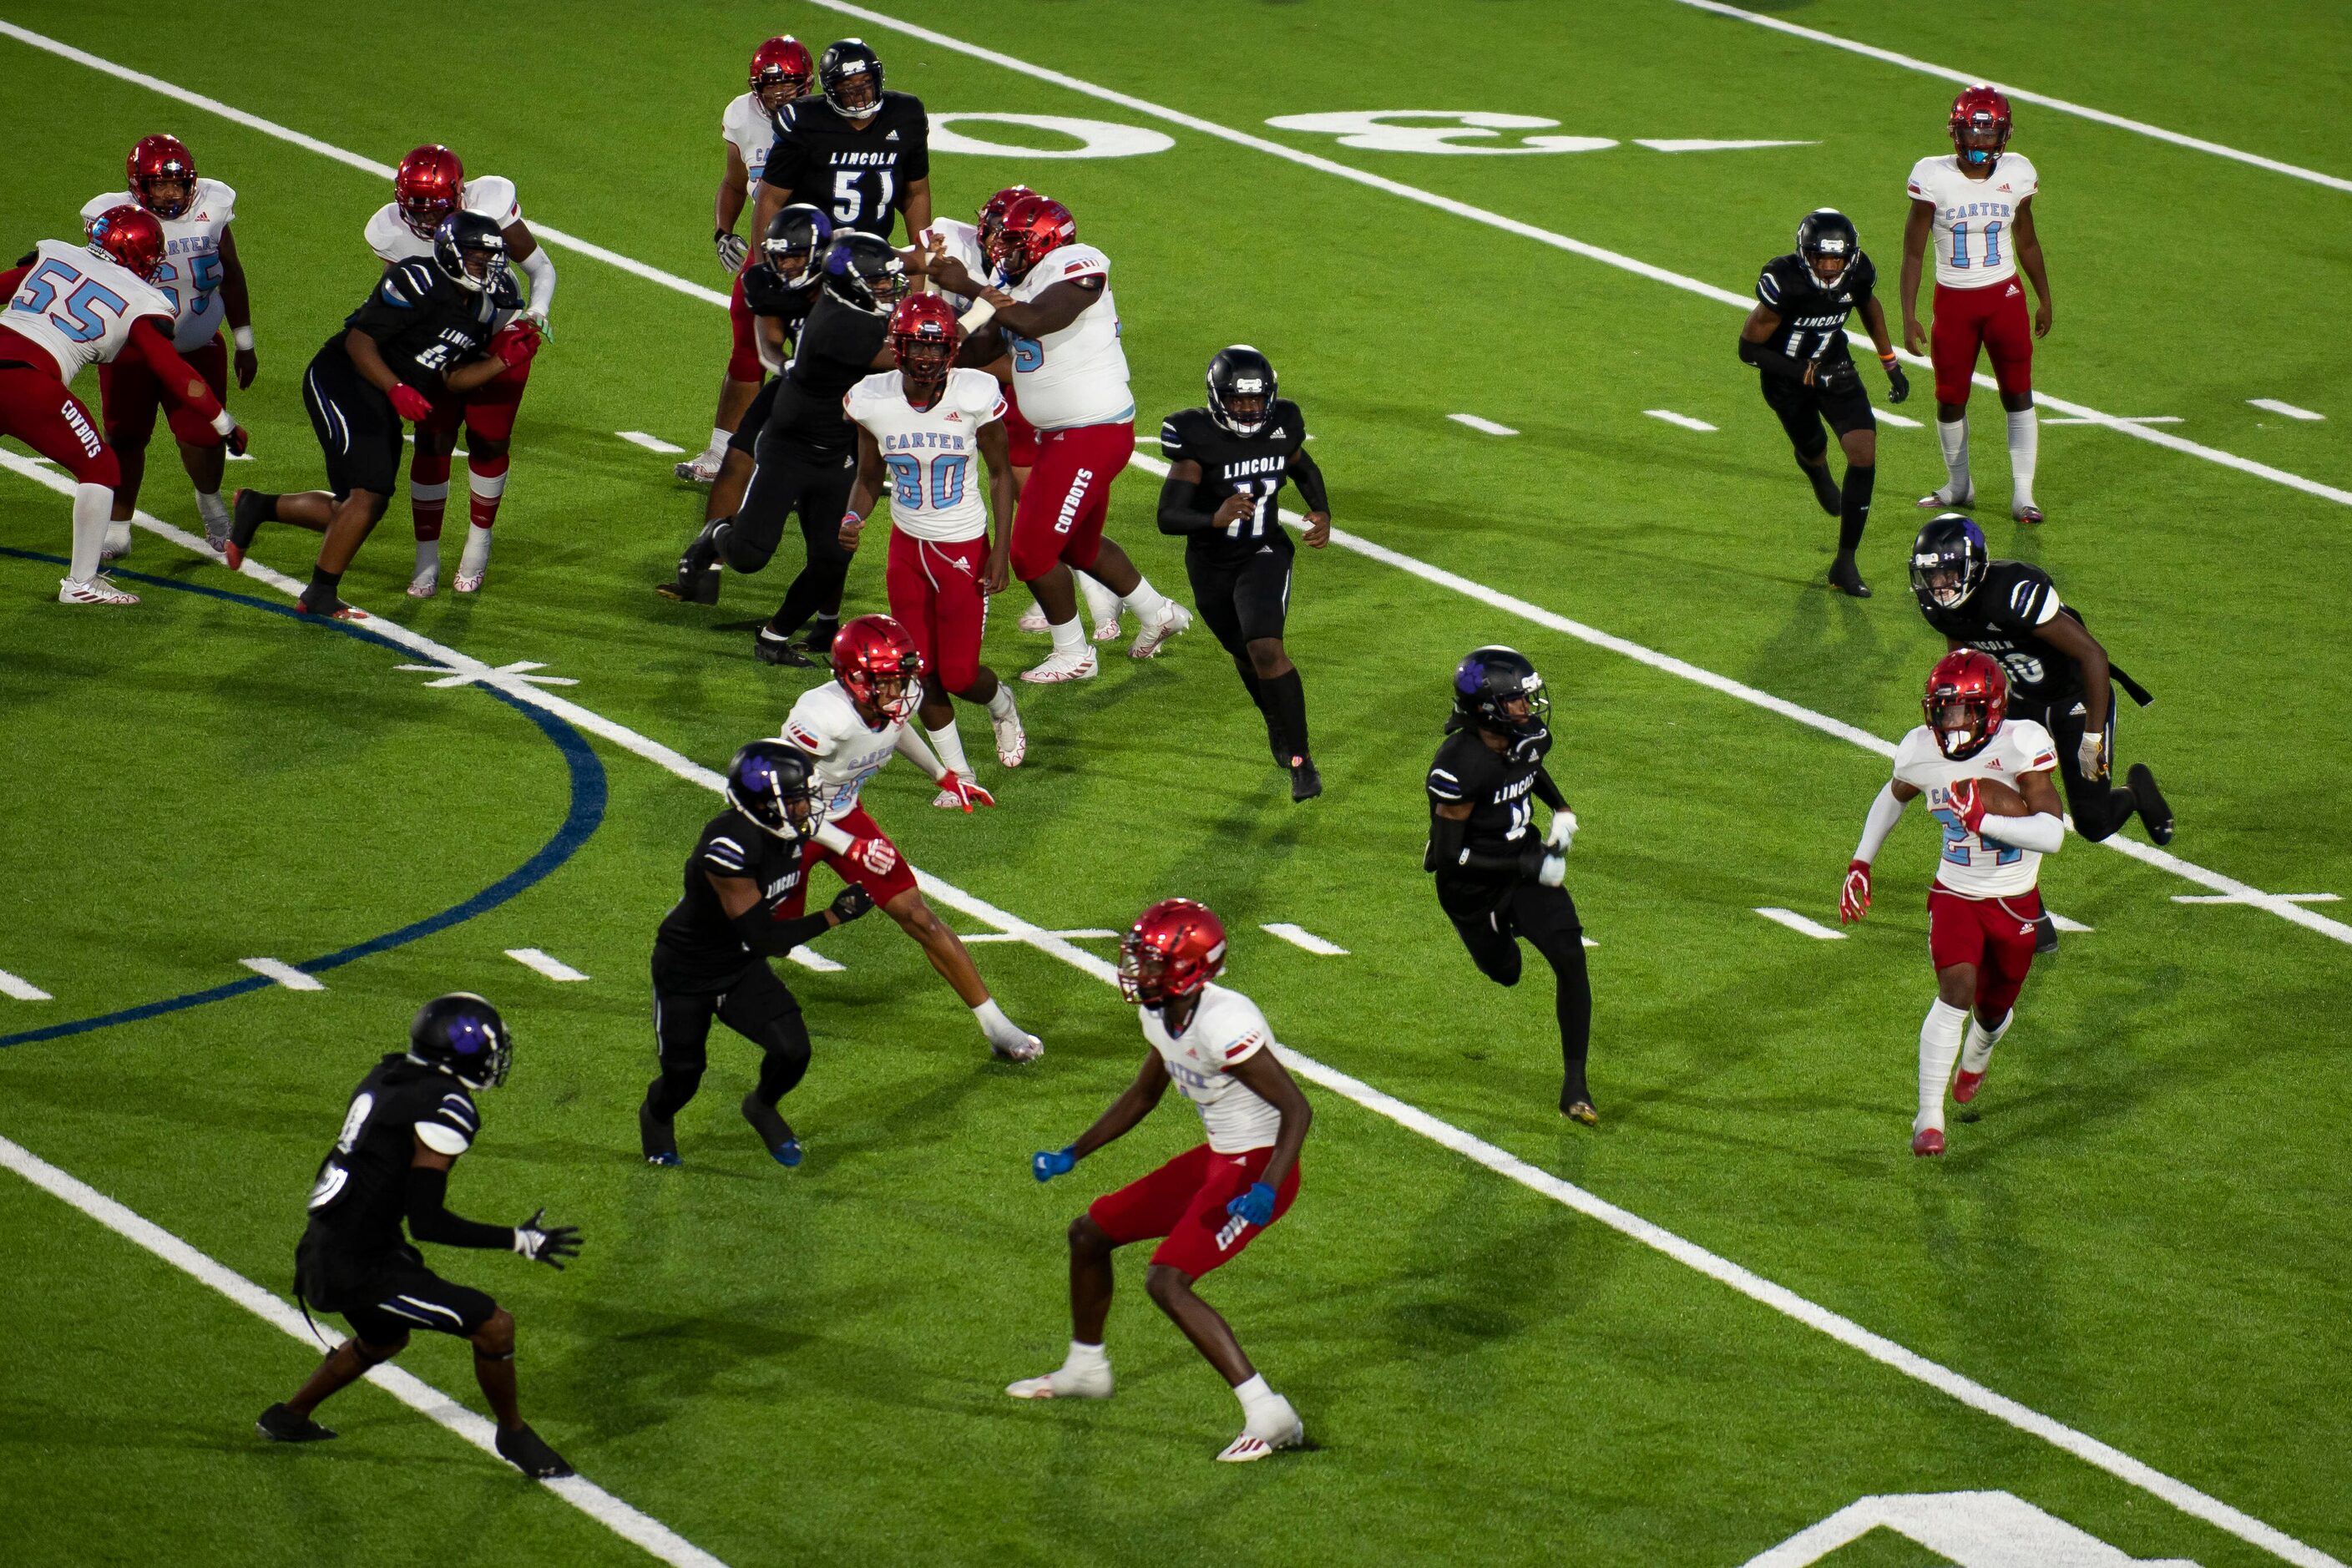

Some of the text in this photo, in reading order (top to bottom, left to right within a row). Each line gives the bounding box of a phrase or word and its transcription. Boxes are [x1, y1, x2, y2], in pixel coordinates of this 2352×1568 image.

[829, 152, 898, 165] LINCOLN
[833, 169, 893, 223] 51
[1945, 202, 2011, 220] CARTER
[168, 236, 210, 255] RTER
[1950, 221, 2002, 269] 11
[12, 257, 129, 343] 55
[1793, 312, 1847, 326] LINCOLN
[1785, 330, 1838, 359] 17
[61, 399, 101, 458] COWBOYS
[885, 432, 964, 450] CARTER
[883, 453, 969, 510] 80
[1224, 456, 1285, 479] LINCOLN
[1055, 468, 1093, 534] COWBOYS
